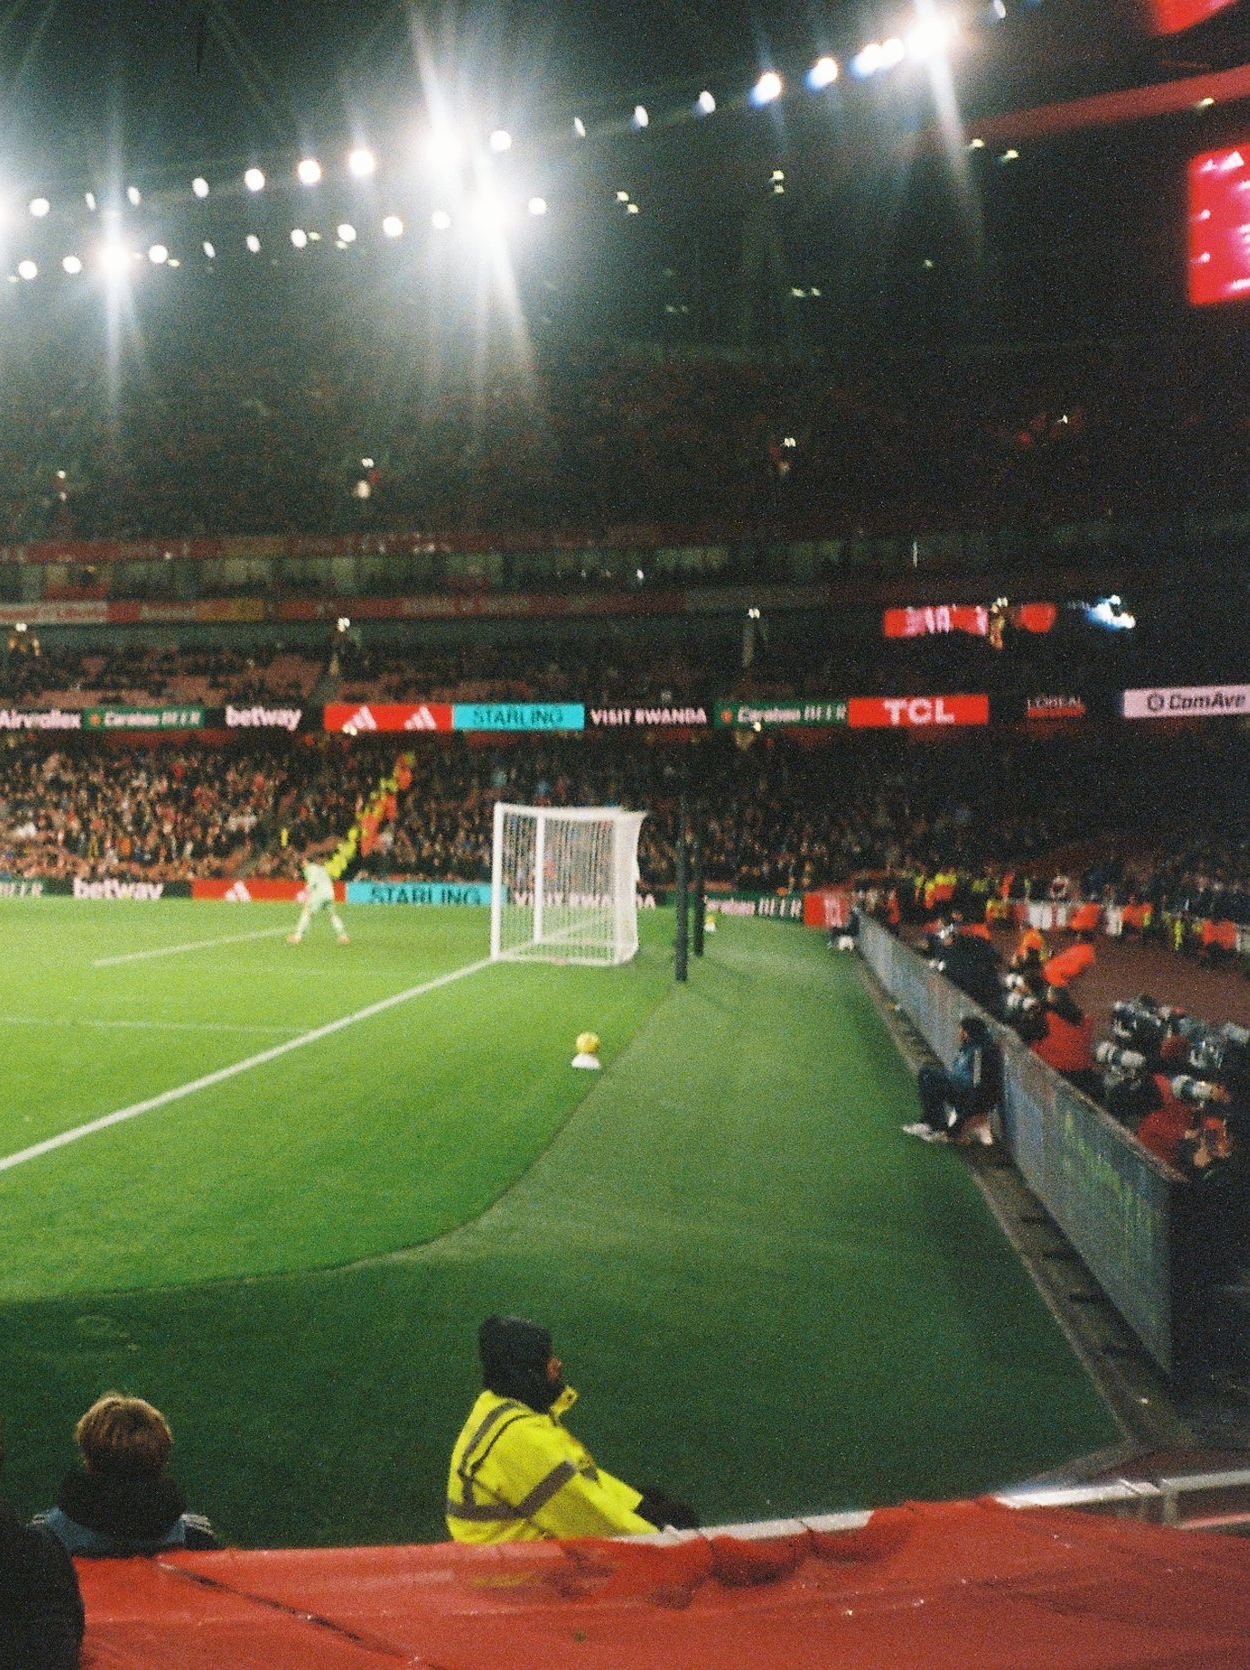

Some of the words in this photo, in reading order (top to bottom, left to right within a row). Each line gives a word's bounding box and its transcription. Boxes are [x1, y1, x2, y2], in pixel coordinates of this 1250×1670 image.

[225, 704, 302, 731] betway
[472, 708, 564, 726] STARLING
[590, 708, 631, 725] VISIT
[634, 707, 707, 725] RWANDA
[882, 698, 955, 726] TCL
[73, 876, 164, 900] betway
[370, 886, 482, 905] STARLING
